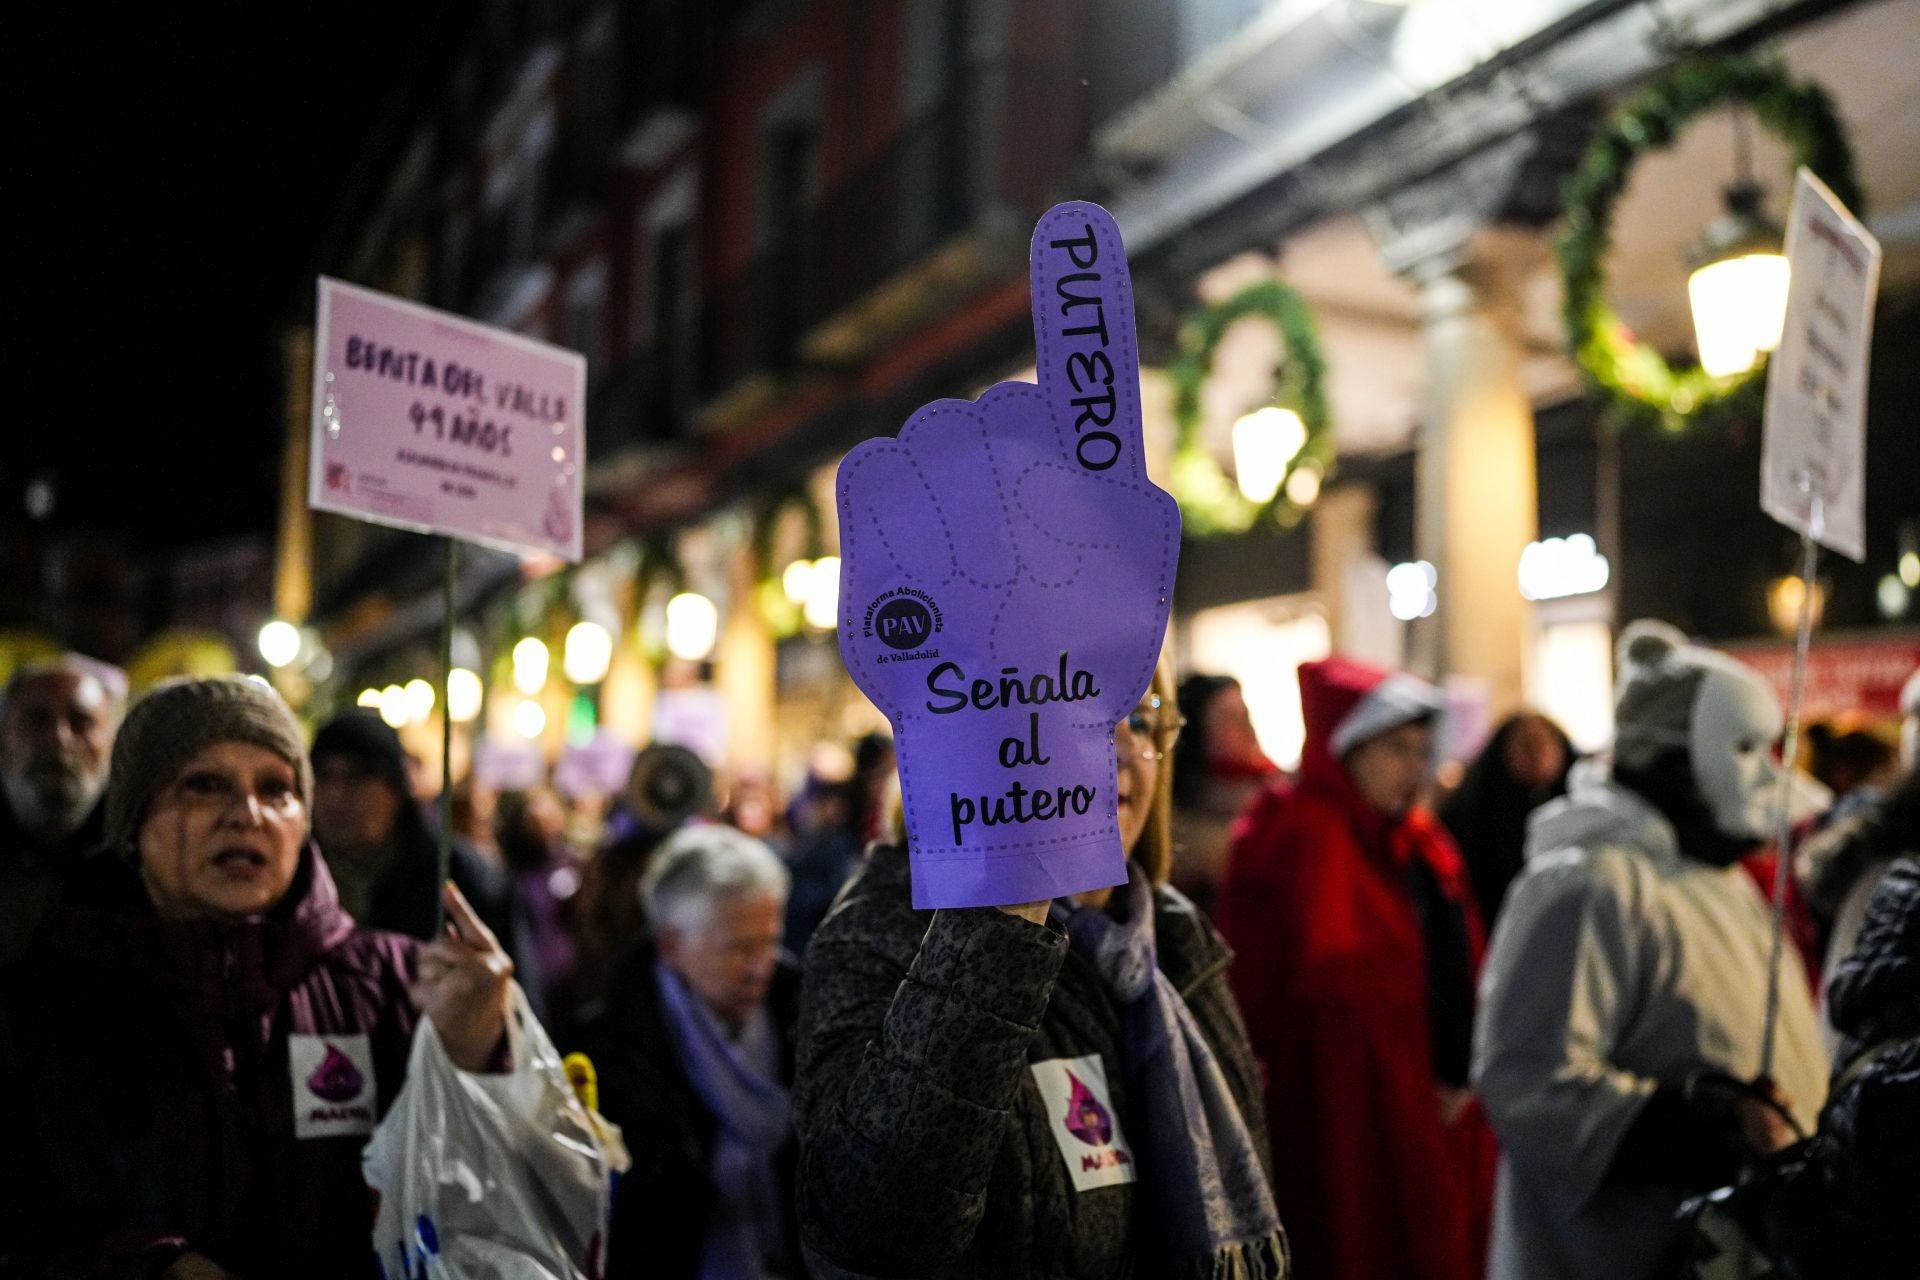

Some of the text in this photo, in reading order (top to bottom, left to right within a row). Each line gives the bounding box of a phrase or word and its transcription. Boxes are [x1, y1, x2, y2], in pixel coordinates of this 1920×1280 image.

[345, 334, 437, 387] BENITA
[1050, 224, 1121, 471] PUTERO
[863, 586, 943, 638] Plataforma Abolicionista
[882, 615, 925, 637] PAV
[877, 649, 939, 664] de Valladolid
[926, 651, 1100, 714] Señala
[999, 712, 1050, 768] al
[951, 781, 1096, 846] putero
